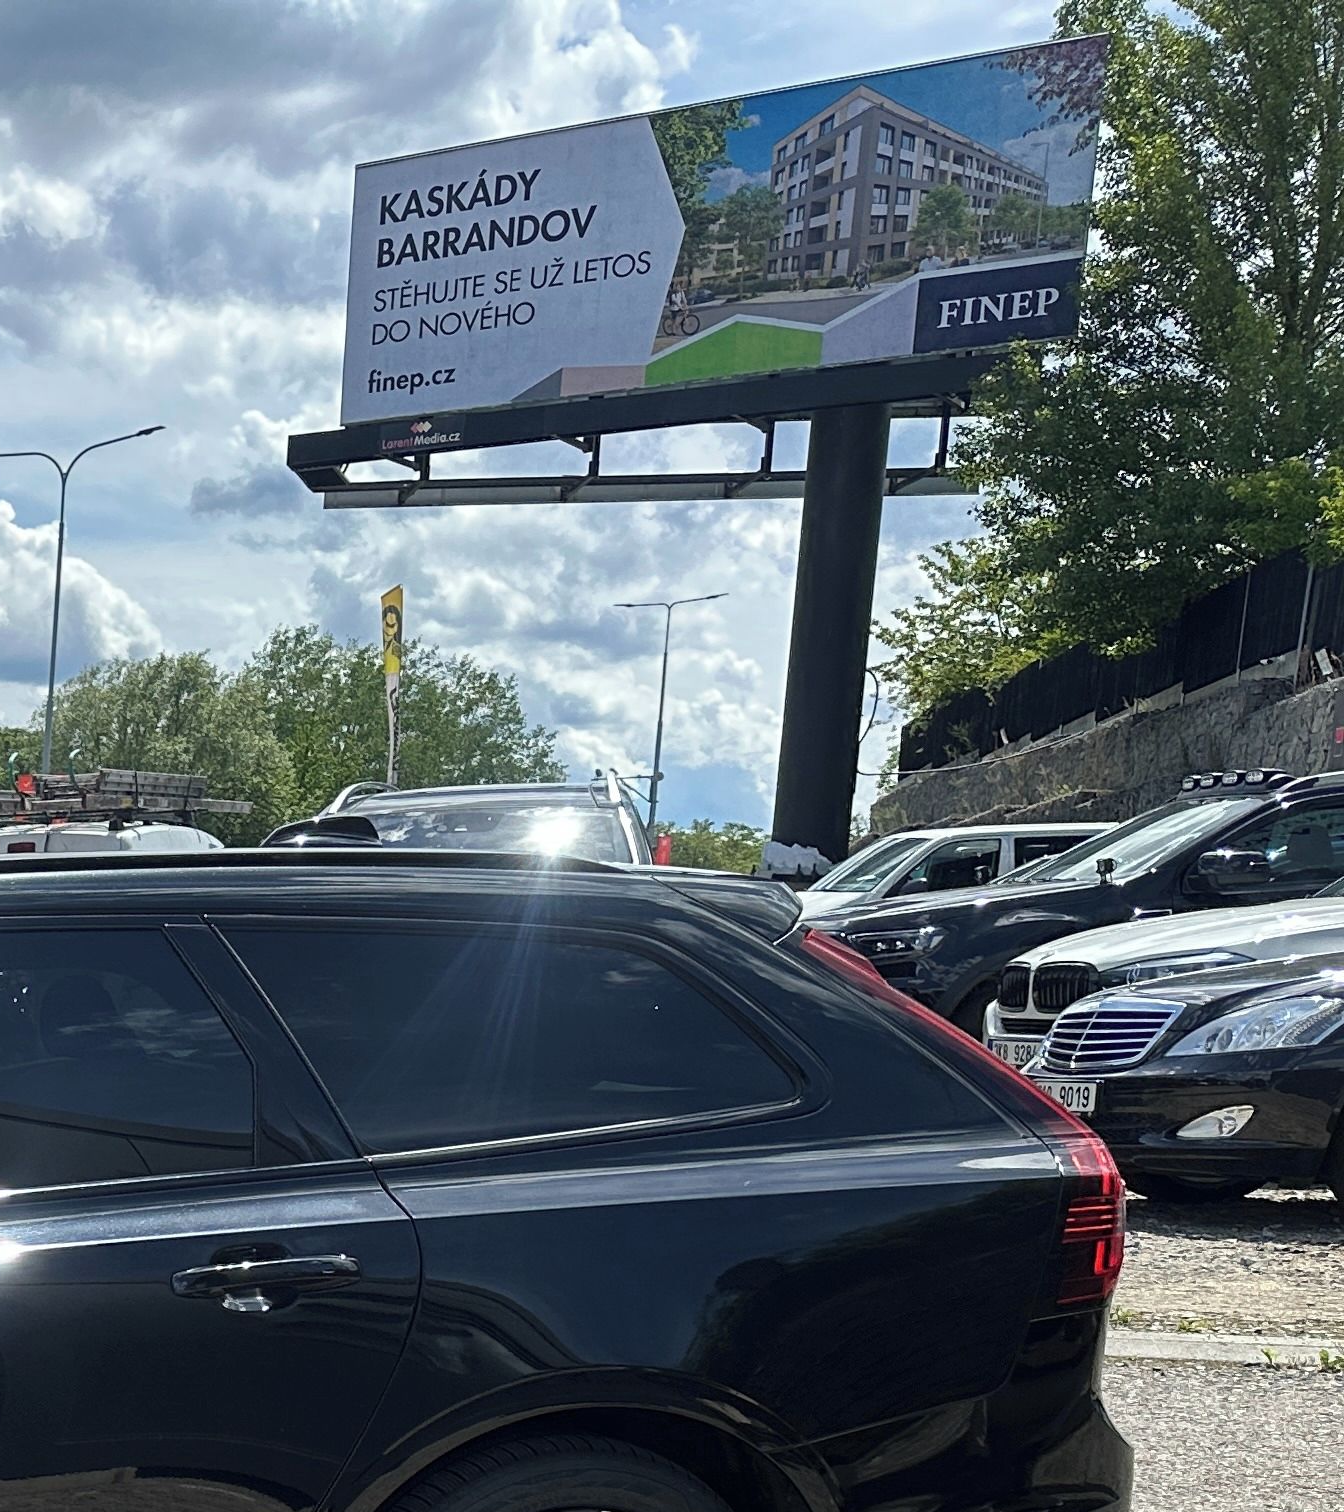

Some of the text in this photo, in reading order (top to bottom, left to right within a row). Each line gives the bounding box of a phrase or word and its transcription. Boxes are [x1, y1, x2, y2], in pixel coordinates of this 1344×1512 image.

[380, 168, 542, 225] KASKÁDY
[377, 204, 597, 268] BARRANDOV
[373, 250, 652, 312] STĚHUJTE SE UŽ LETOS
[372, 301, 535, 345] DO NOVÉHO
[936, 287, 1060, 329] FINEP
[368, 368, 456, 395] finep.cz
[1059, 1086, 1090, 1108] 9019
